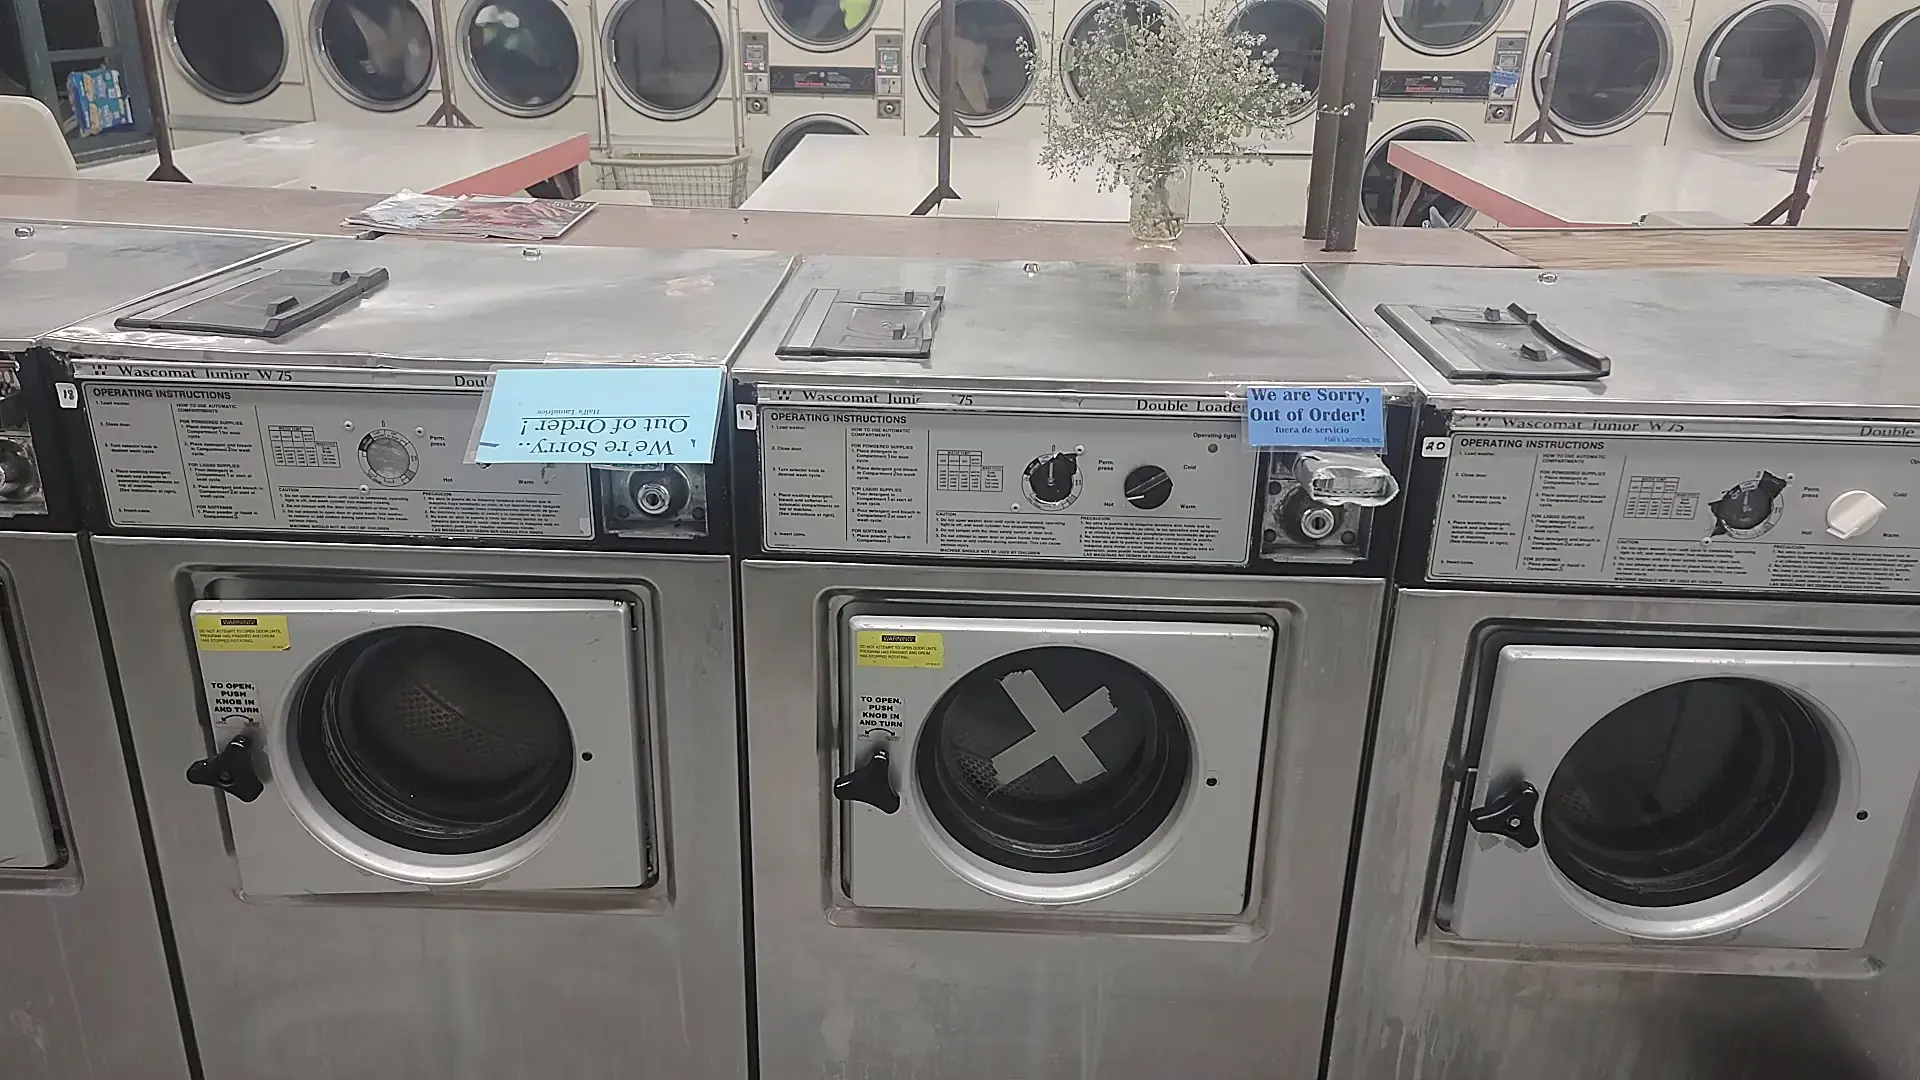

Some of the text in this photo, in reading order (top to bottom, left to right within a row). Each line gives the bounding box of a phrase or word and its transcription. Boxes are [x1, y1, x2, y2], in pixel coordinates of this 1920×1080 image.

[117, 365, 292, 381] Wascomat Junior W 75
[62, 388, 74, 400] 18
[93, 388, 231, 399] OPERATING INSTRUCTIONS
[802, 390, 879, 404] Wascomat
[958, 395, 973, 405] 75
[1251, 388, 1370, 403] We are Sorry,
[1136, 400, 1188, 412] Double
[740, 410, 752, 420] 19
[770, 413, 907, 424] OPERATING INSTRUCTIONS
[1250, 408, 1365, 422] Out of Order!
[608, 418, 636, 434] of
[643, 419, 687, 432] Out
[1276, 426, 1299, 434] fuera
[1502, 418, 1583, 430] Wascomat
[1860, 426, 1914, 438] Double
[604, 439, 673, 456] We're
[1426, 441, 1446, 450] 20
[1460, 438, 1604, 450] OPERATING INSTRUCTIONS
